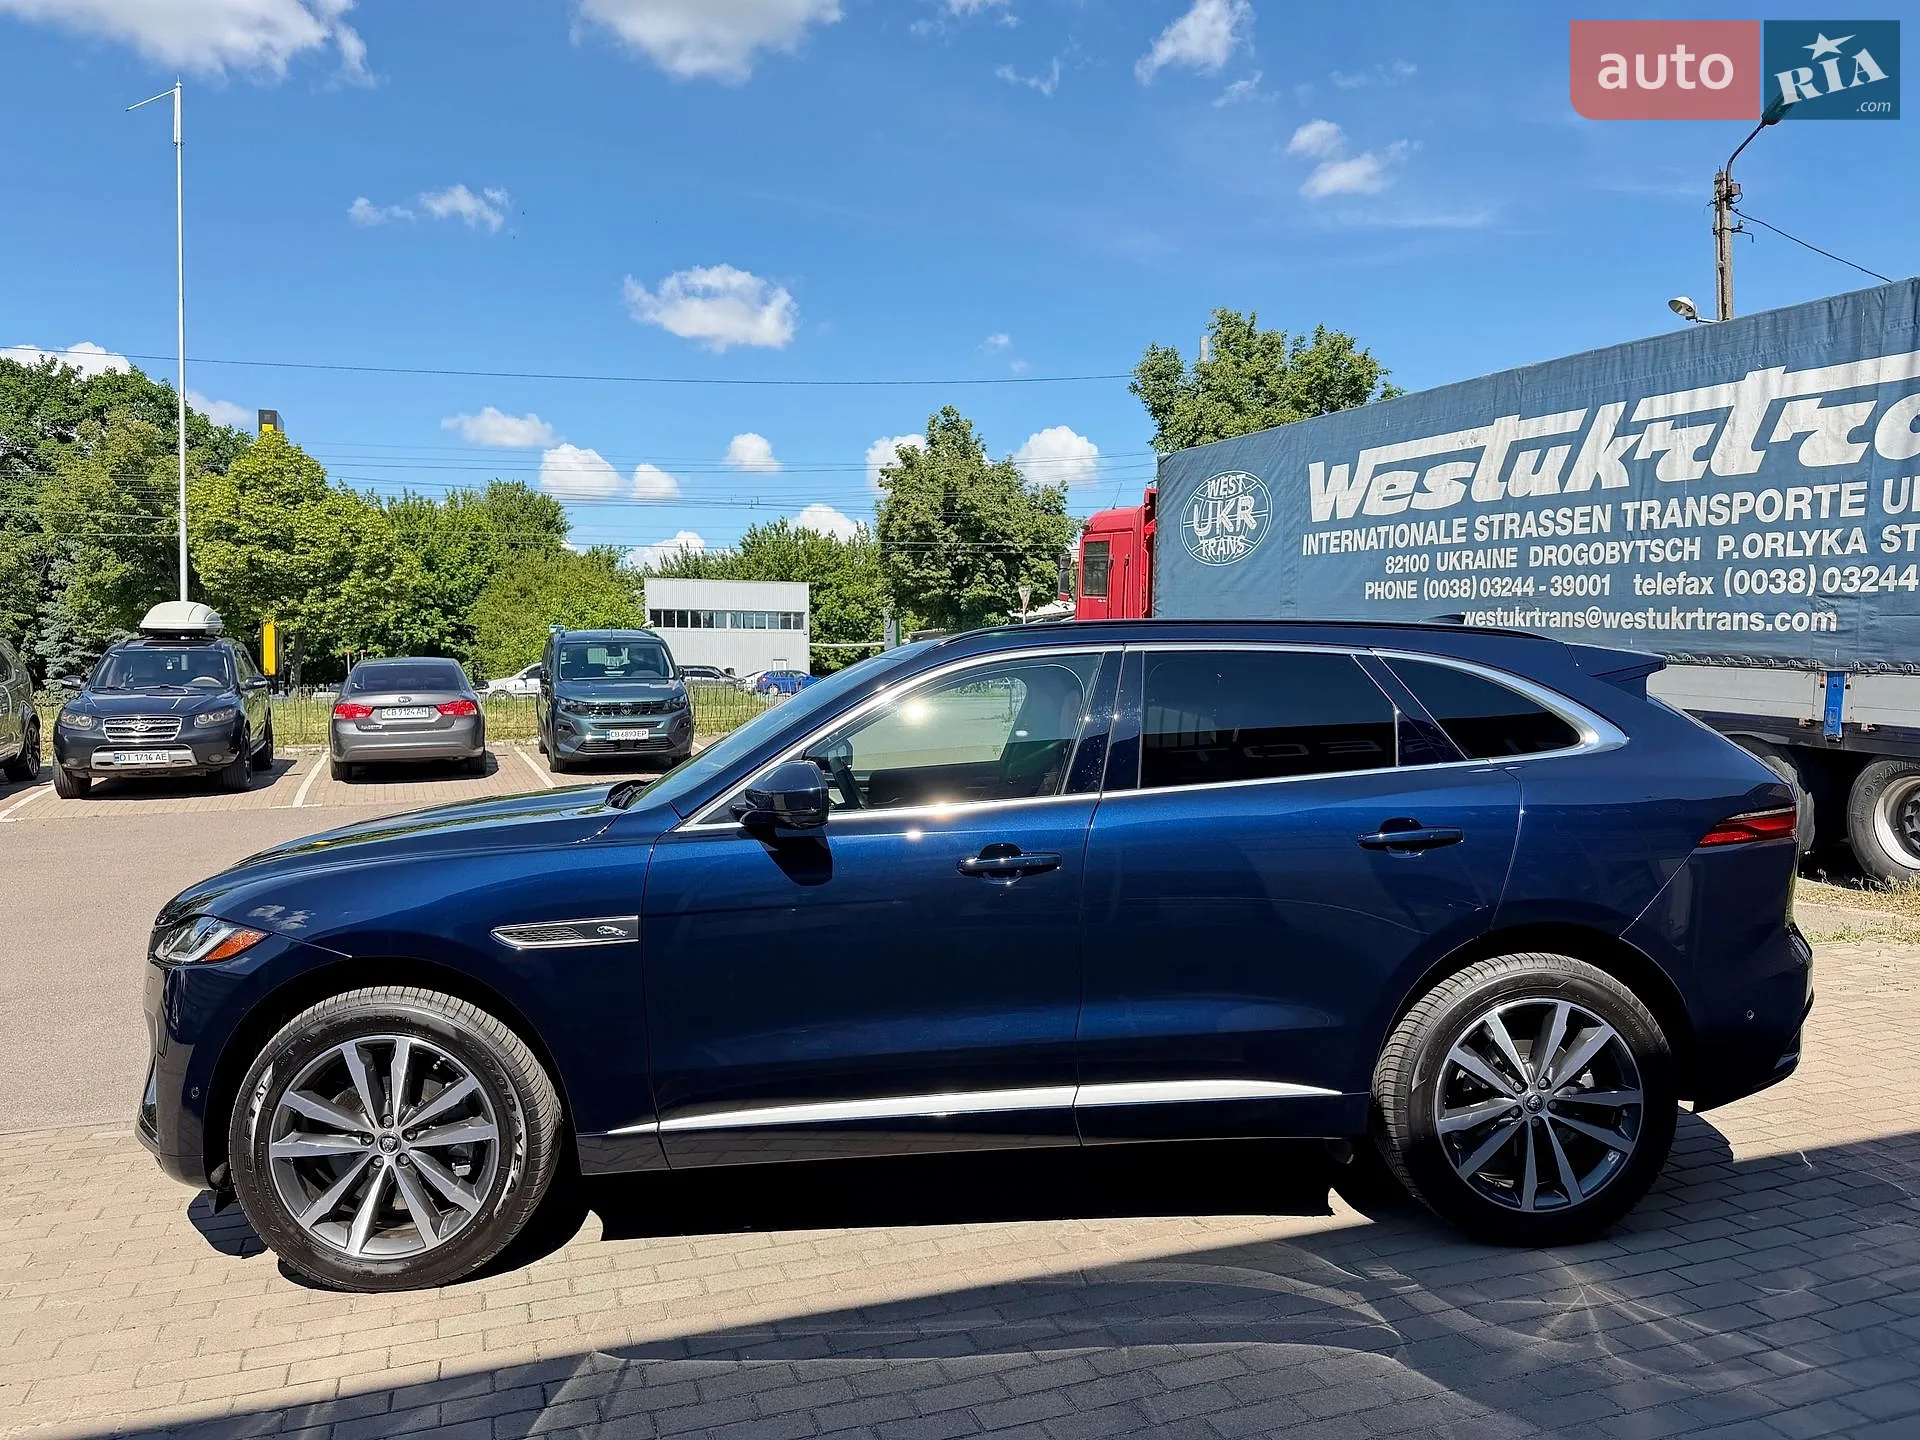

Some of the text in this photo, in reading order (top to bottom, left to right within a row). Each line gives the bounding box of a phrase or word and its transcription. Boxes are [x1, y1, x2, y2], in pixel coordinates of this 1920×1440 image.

[1208, 473, 1246, 499] WEST
[1193, 494, 1257, 537] UKR
[1302, 517, 1468, 555] INTERNATIONALE
[1474, 504, 1612, 541] STRASSEN
[1621, 481, 1868, 532] TRANSPORTE
[1199, 533, 1247, 557] TRANS
[1385, 553, 1429, 574] 82100
[1436, 547, 1518, 571] UKRAINE
[1528, 537, 1700, 568] DROGOBYTSCH
[1717, 527, 1867, 560] P.ORLYKA
[1365, 579, 1418, 600] PHONE
[1633, 572, 1714, 596] telefax
[1461, 606, 1837, 632] westukrtrans@westukrtrans.com
[154, 752, 168, 761] AE
